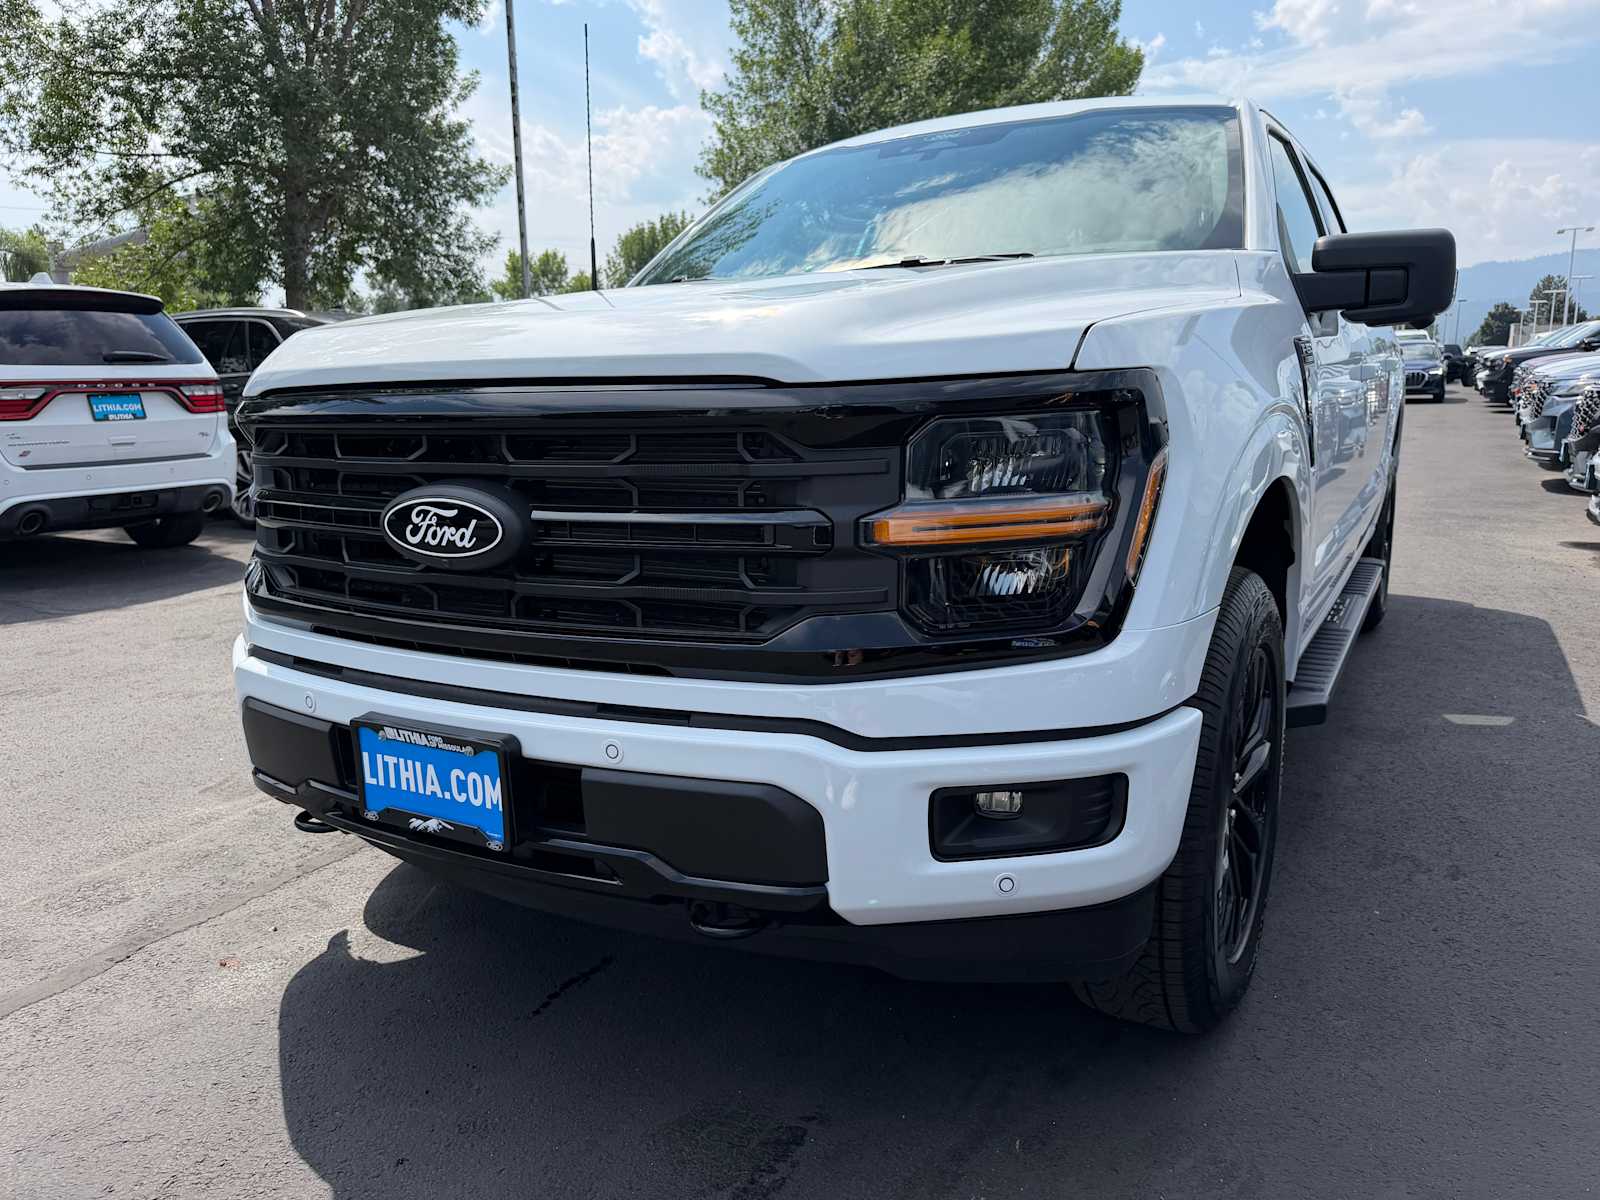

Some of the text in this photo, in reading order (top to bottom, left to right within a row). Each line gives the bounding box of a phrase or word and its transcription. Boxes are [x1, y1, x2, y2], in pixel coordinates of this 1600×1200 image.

[93, 403, 142, 413] LITHIA.COM
[405, 505, 478, 548] Ford
[393, 727, 430, 747] LITHIA
[362, 751, 503, 812] LITHIA.COM
